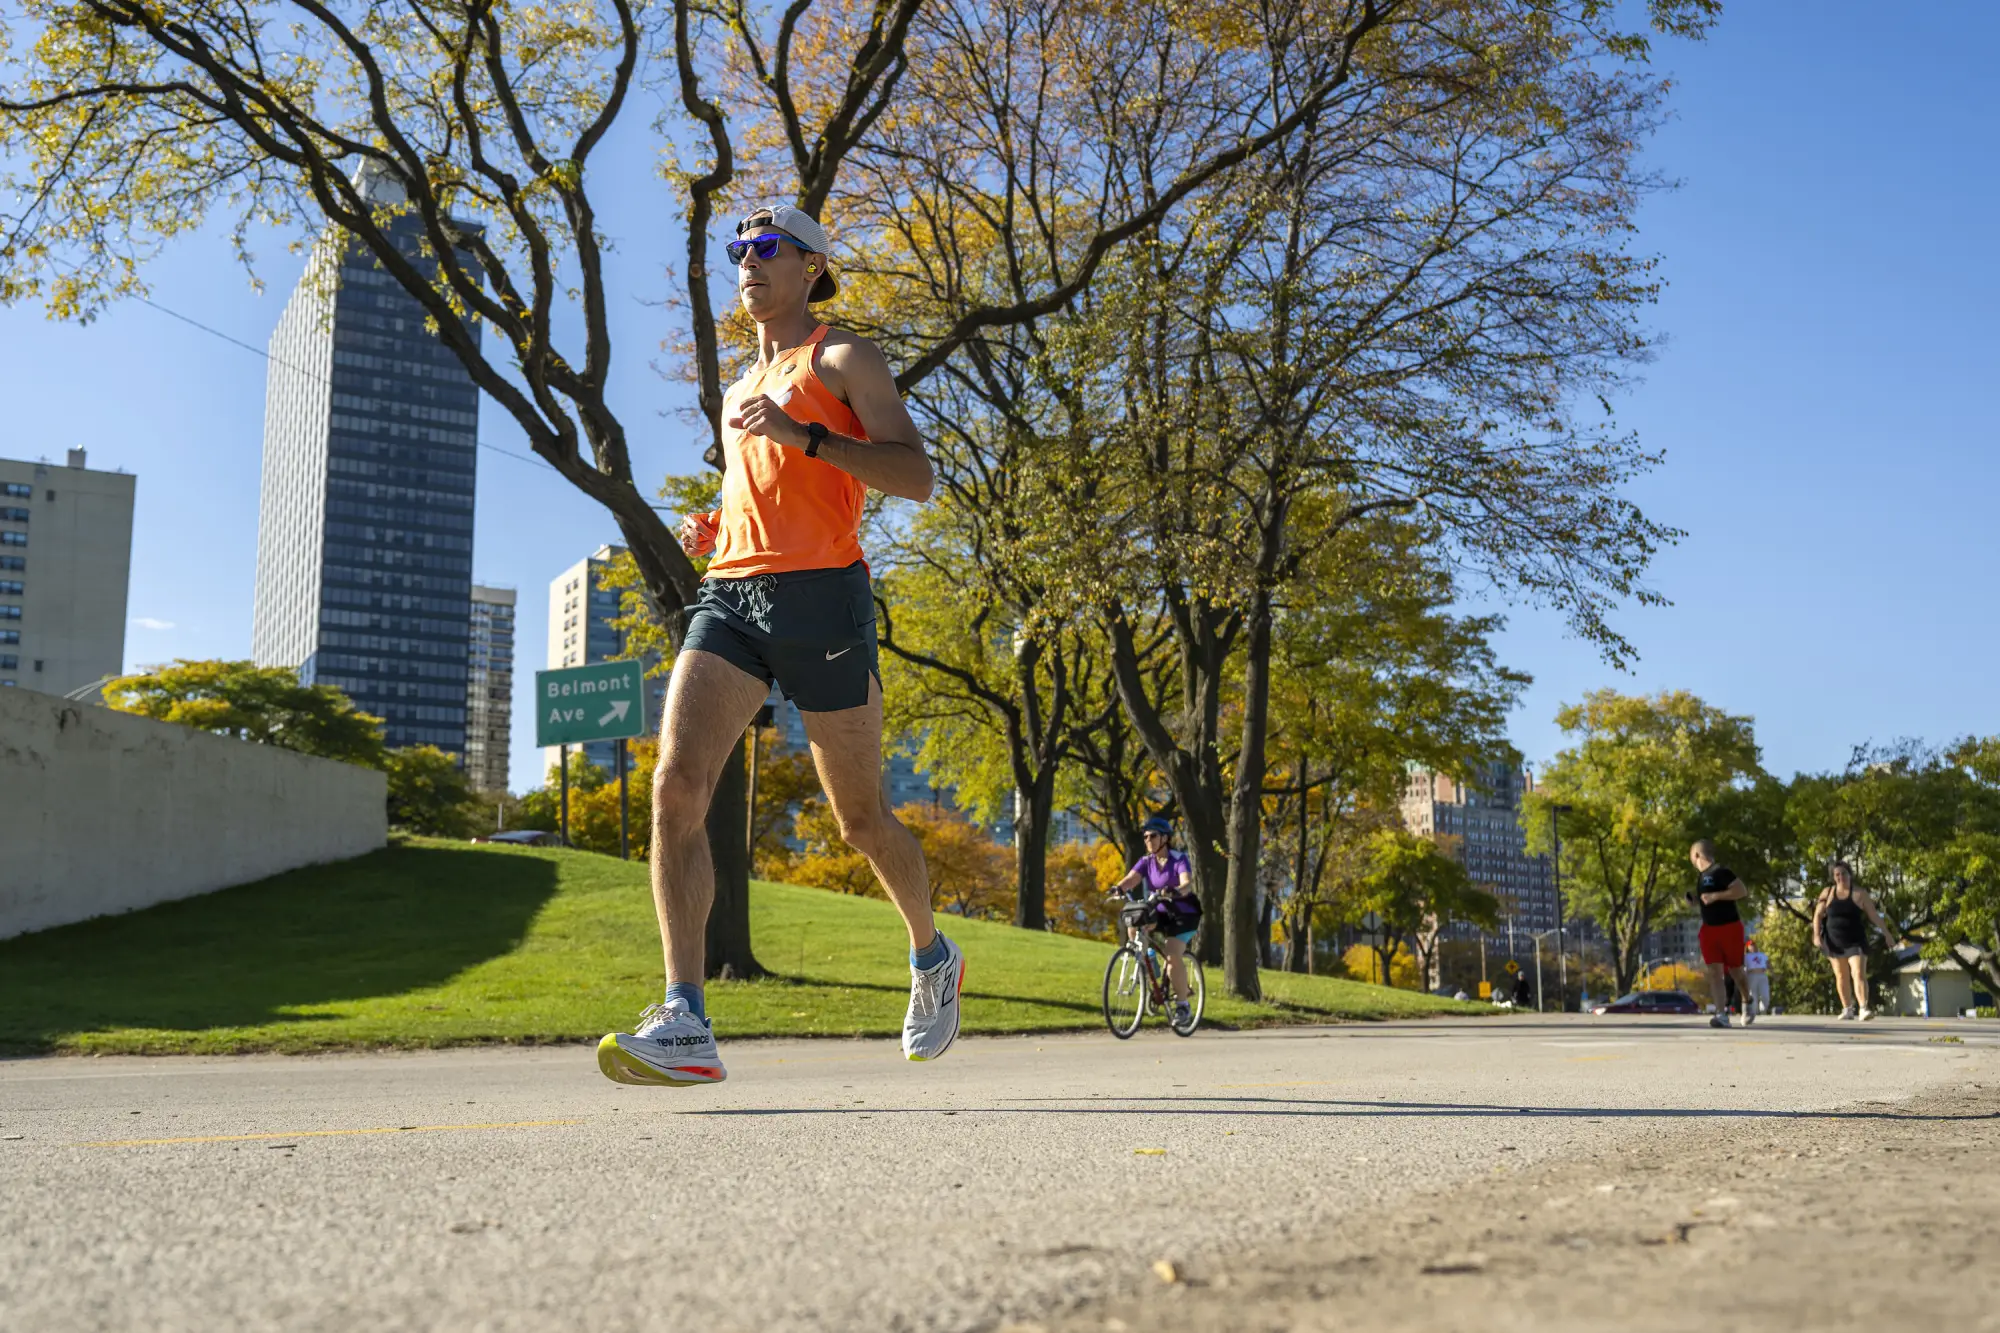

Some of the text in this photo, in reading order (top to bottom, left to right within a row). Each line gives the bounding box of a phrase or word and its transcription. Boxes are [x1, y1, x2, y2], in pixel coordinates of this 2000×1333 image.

[547, 673, 630, 698] Belmont
[548, 708, 585, 724] Ave
[656, 1034, 710, 1047] new balance
